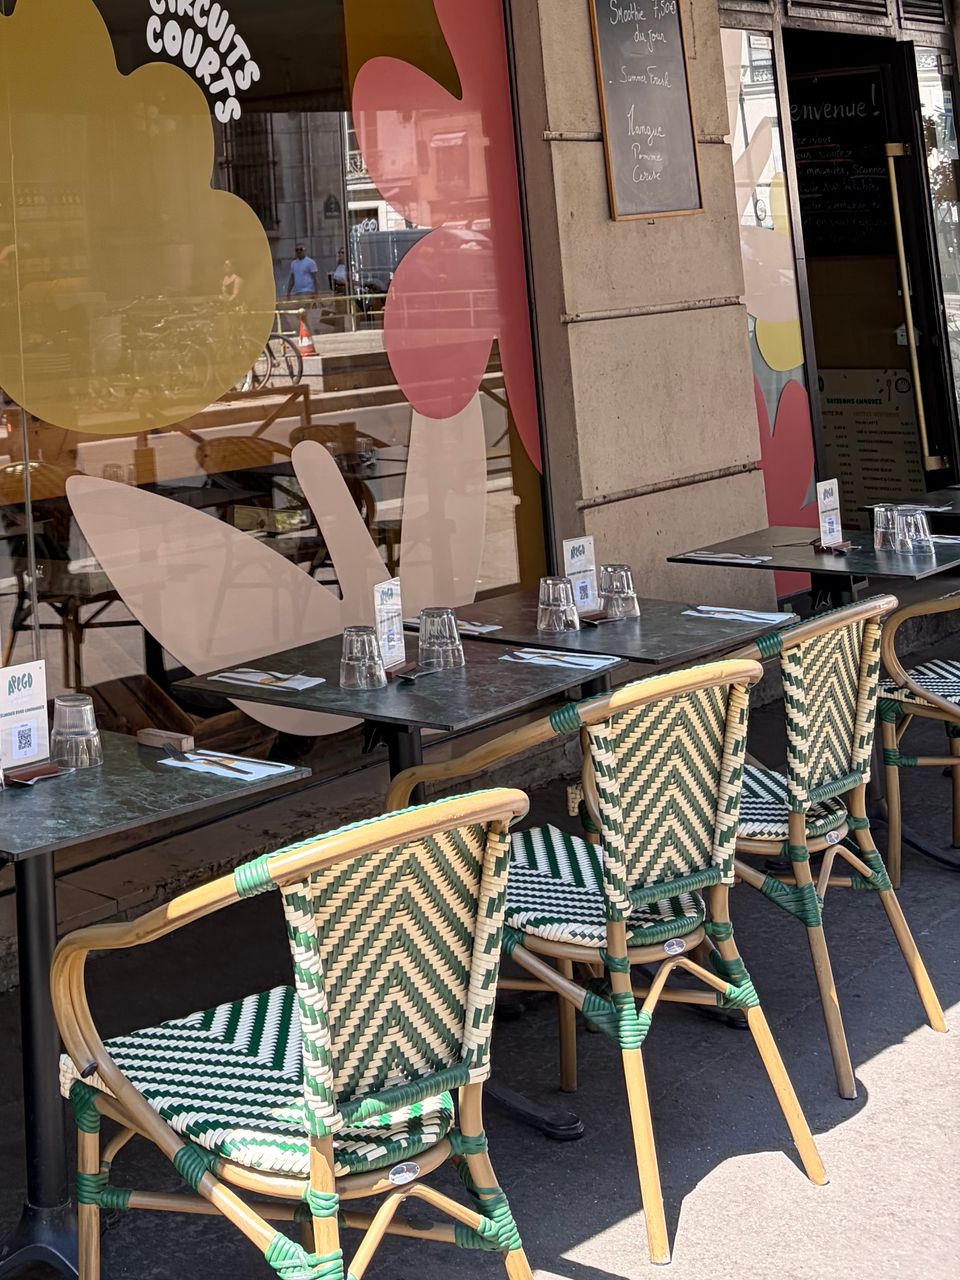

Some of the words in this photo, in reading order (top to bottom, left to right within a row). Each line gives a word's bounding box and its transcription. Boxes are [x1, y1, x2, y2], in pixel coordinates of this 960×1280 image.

[633, 24, 647, 42] du
[647, 29, 668, 53] jour
[146, 15, 241, 123] COURTS
[631, 142, 663, 161] Pomme
[632, 164, 661, 183] Cerise
